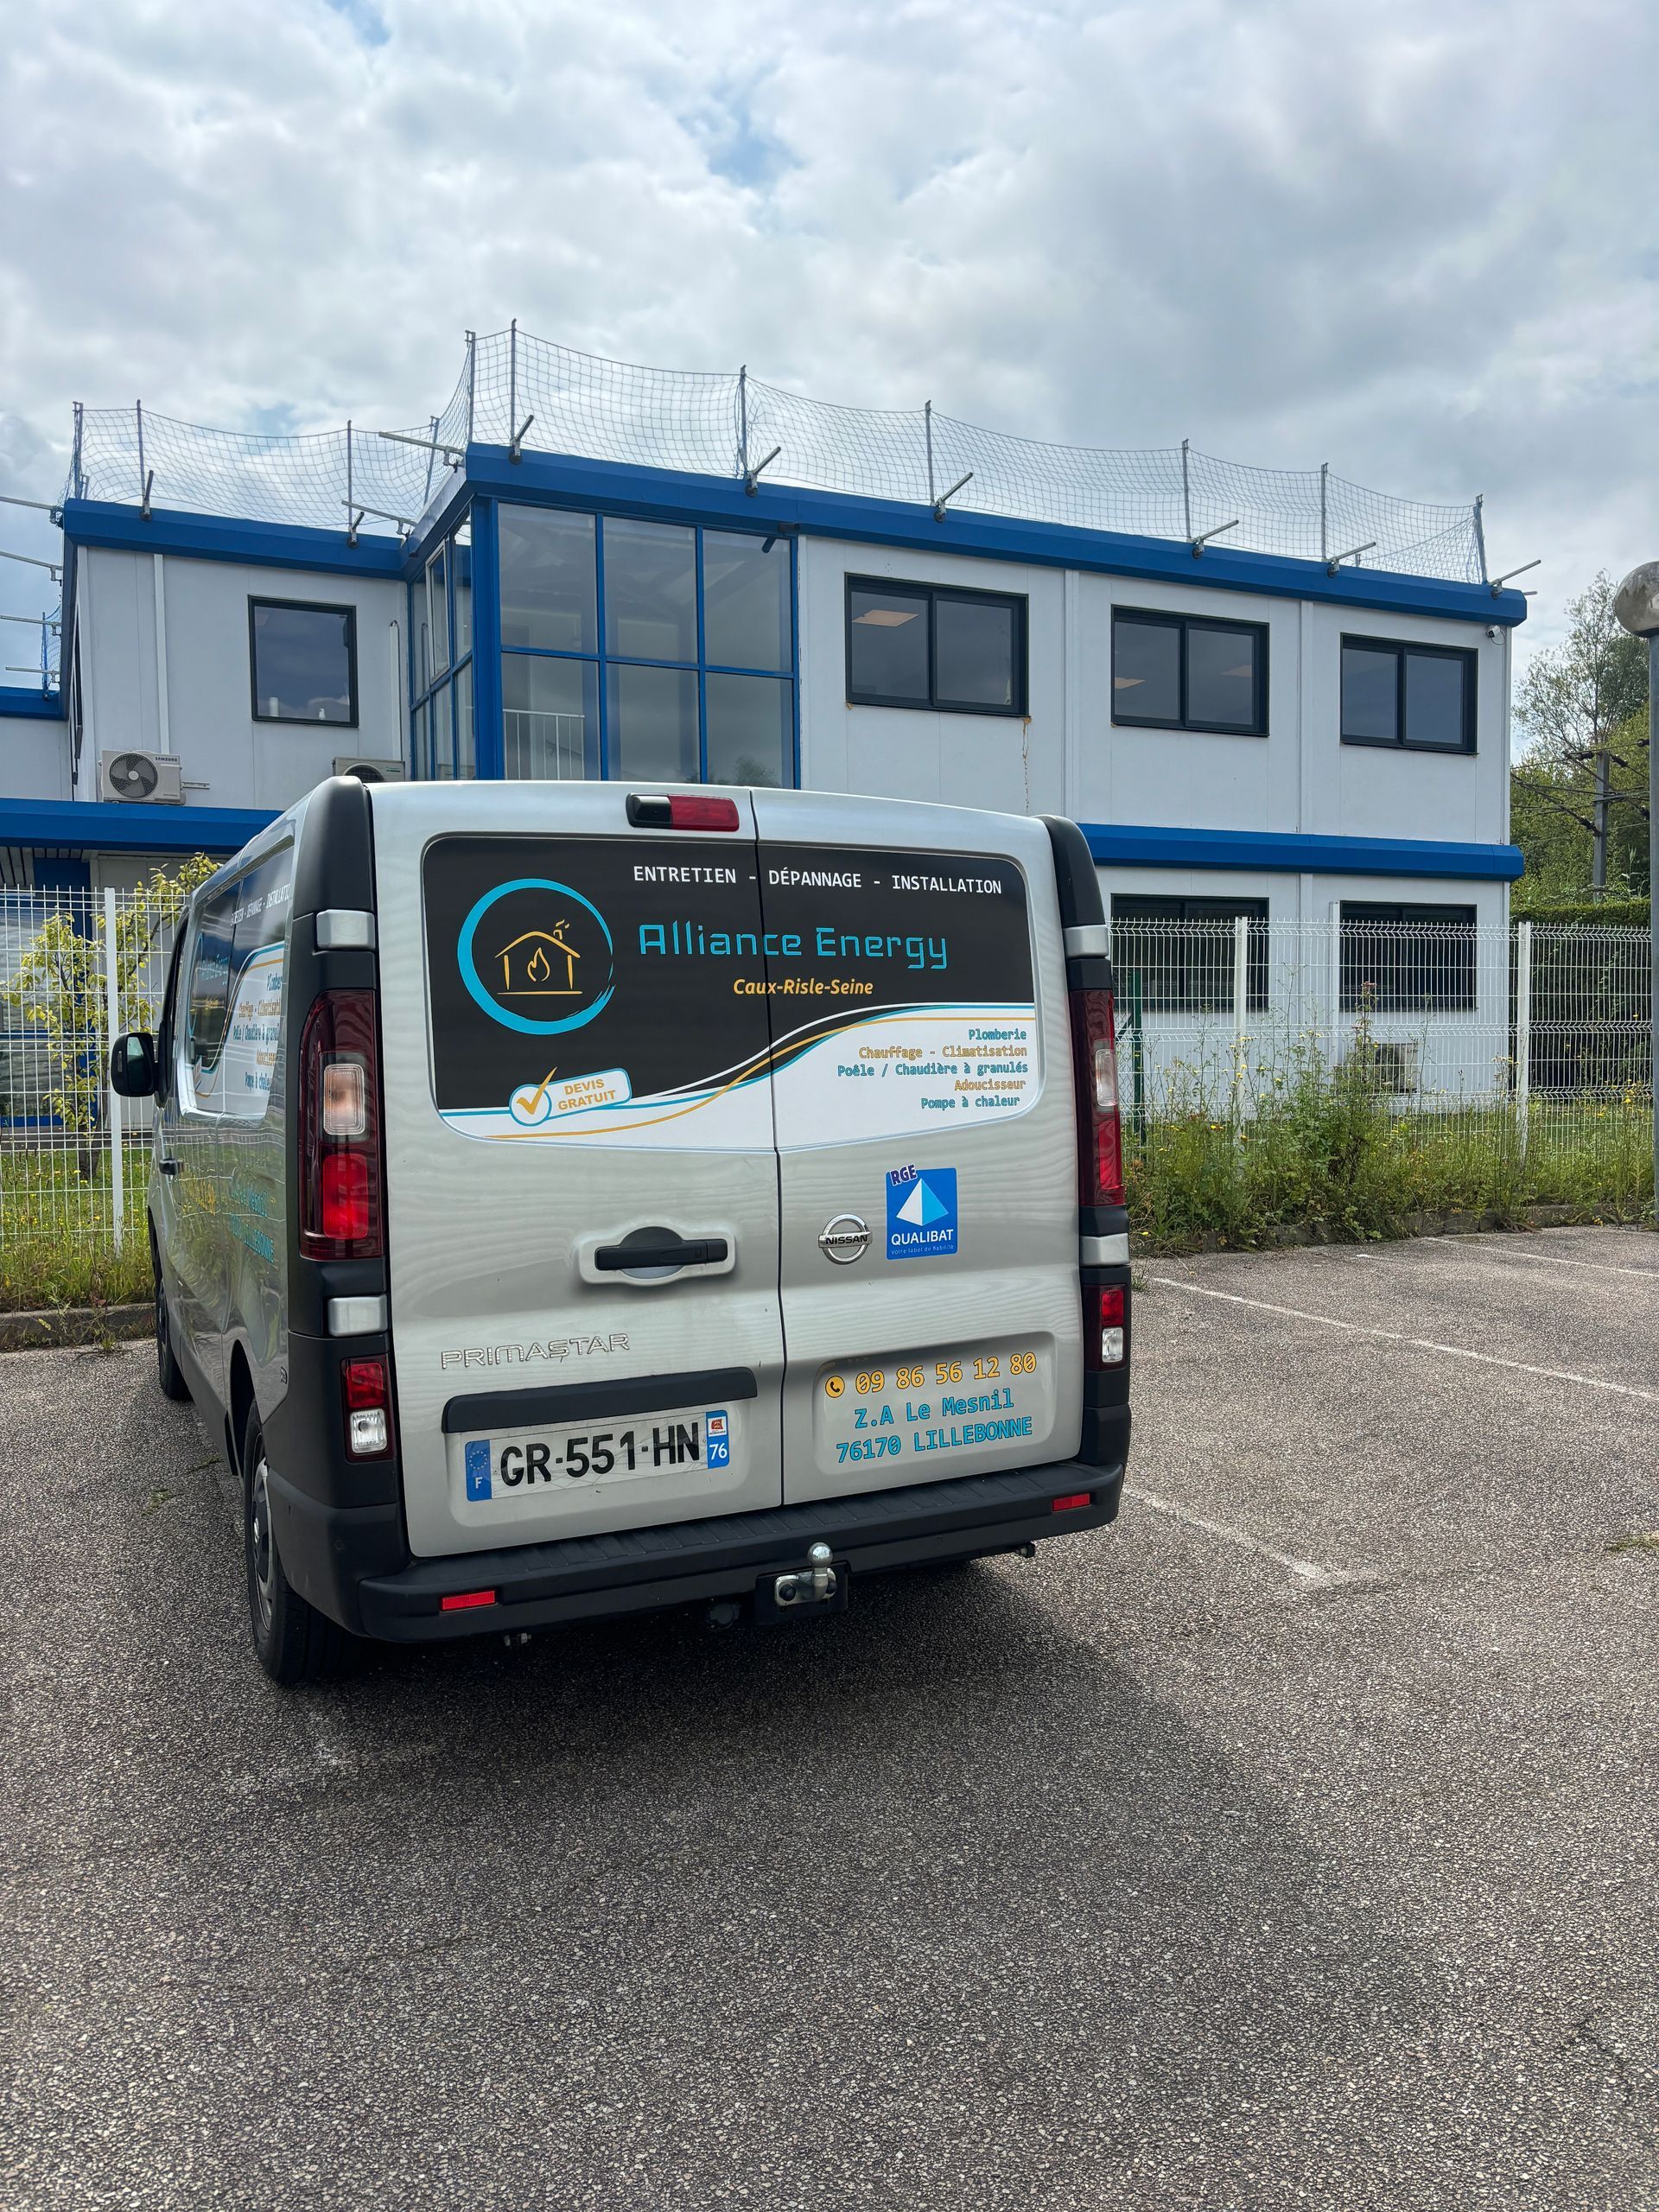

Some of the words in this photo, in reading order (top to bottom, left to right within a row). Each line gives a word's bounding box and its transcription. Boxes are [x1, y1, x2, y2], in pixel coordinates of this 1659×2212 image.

[633, 867, 736, 885] ENTRETIEN
[769, 867, 861, 888] DÉPANNAGE
[893, 875, 1002, 895] INSTALLATION
[639, 920, 802, 957] Alliance
[817, 927, 948, 969] Energy
[733, 978, 874, 995] Caux-Risle-Seine
[969, 1028, 1027, 1040] Plomberie
[858, 1046, 923, 1061] Chauffage
[942, 1045, 1027, 1058] Climatisation
[837, 1064, 874, 1077] Poêle
[895, 1063, 957, 1076] Chaudière
[963, 1063, 971, 1074] à
[977, 1061, 1028, 1077] granulés
[564, 1078, 605, 1096] DEVIS
[954, 1078, 1027, 1091] Adoucisseur
[557, 1090, 616, 1110] GRATUIT
[921, 1097, 956, 1111] Pompe
[962, 1096, 969, 1108] à
[975, 1095, 1020, 1108] chaleur
[890, 1164, 918, 1185] RGE
[825, 1234, 868, 1245] NISSAN
[891, 1229, 954, 1246] QUALIBAT
[441, 1332, 631, 1370] PRIMASTAR
[855, 1370, 885, 1395] 09
[896, 1365, 925, 1389] 86
[935, 1361, 963, 1385] 56
[973, 1357, 1001, 1380] 12
[1010, 1351, 1037, 1375] 80
[855, 1405, 894, 1428] Z.A
[906, 1402, 931, 1421] Le
[942, 1388, 1014, 1416] Mesnil
[836, 1435, 901, 1463] 76170
[913, 1416, 1033, 1452] LILLEBONNE
[475, 1476, 482, 1490] F
[500, 1422, 700, 1487] GR-551-HN
[709, 1442, 728, 1460] 76
